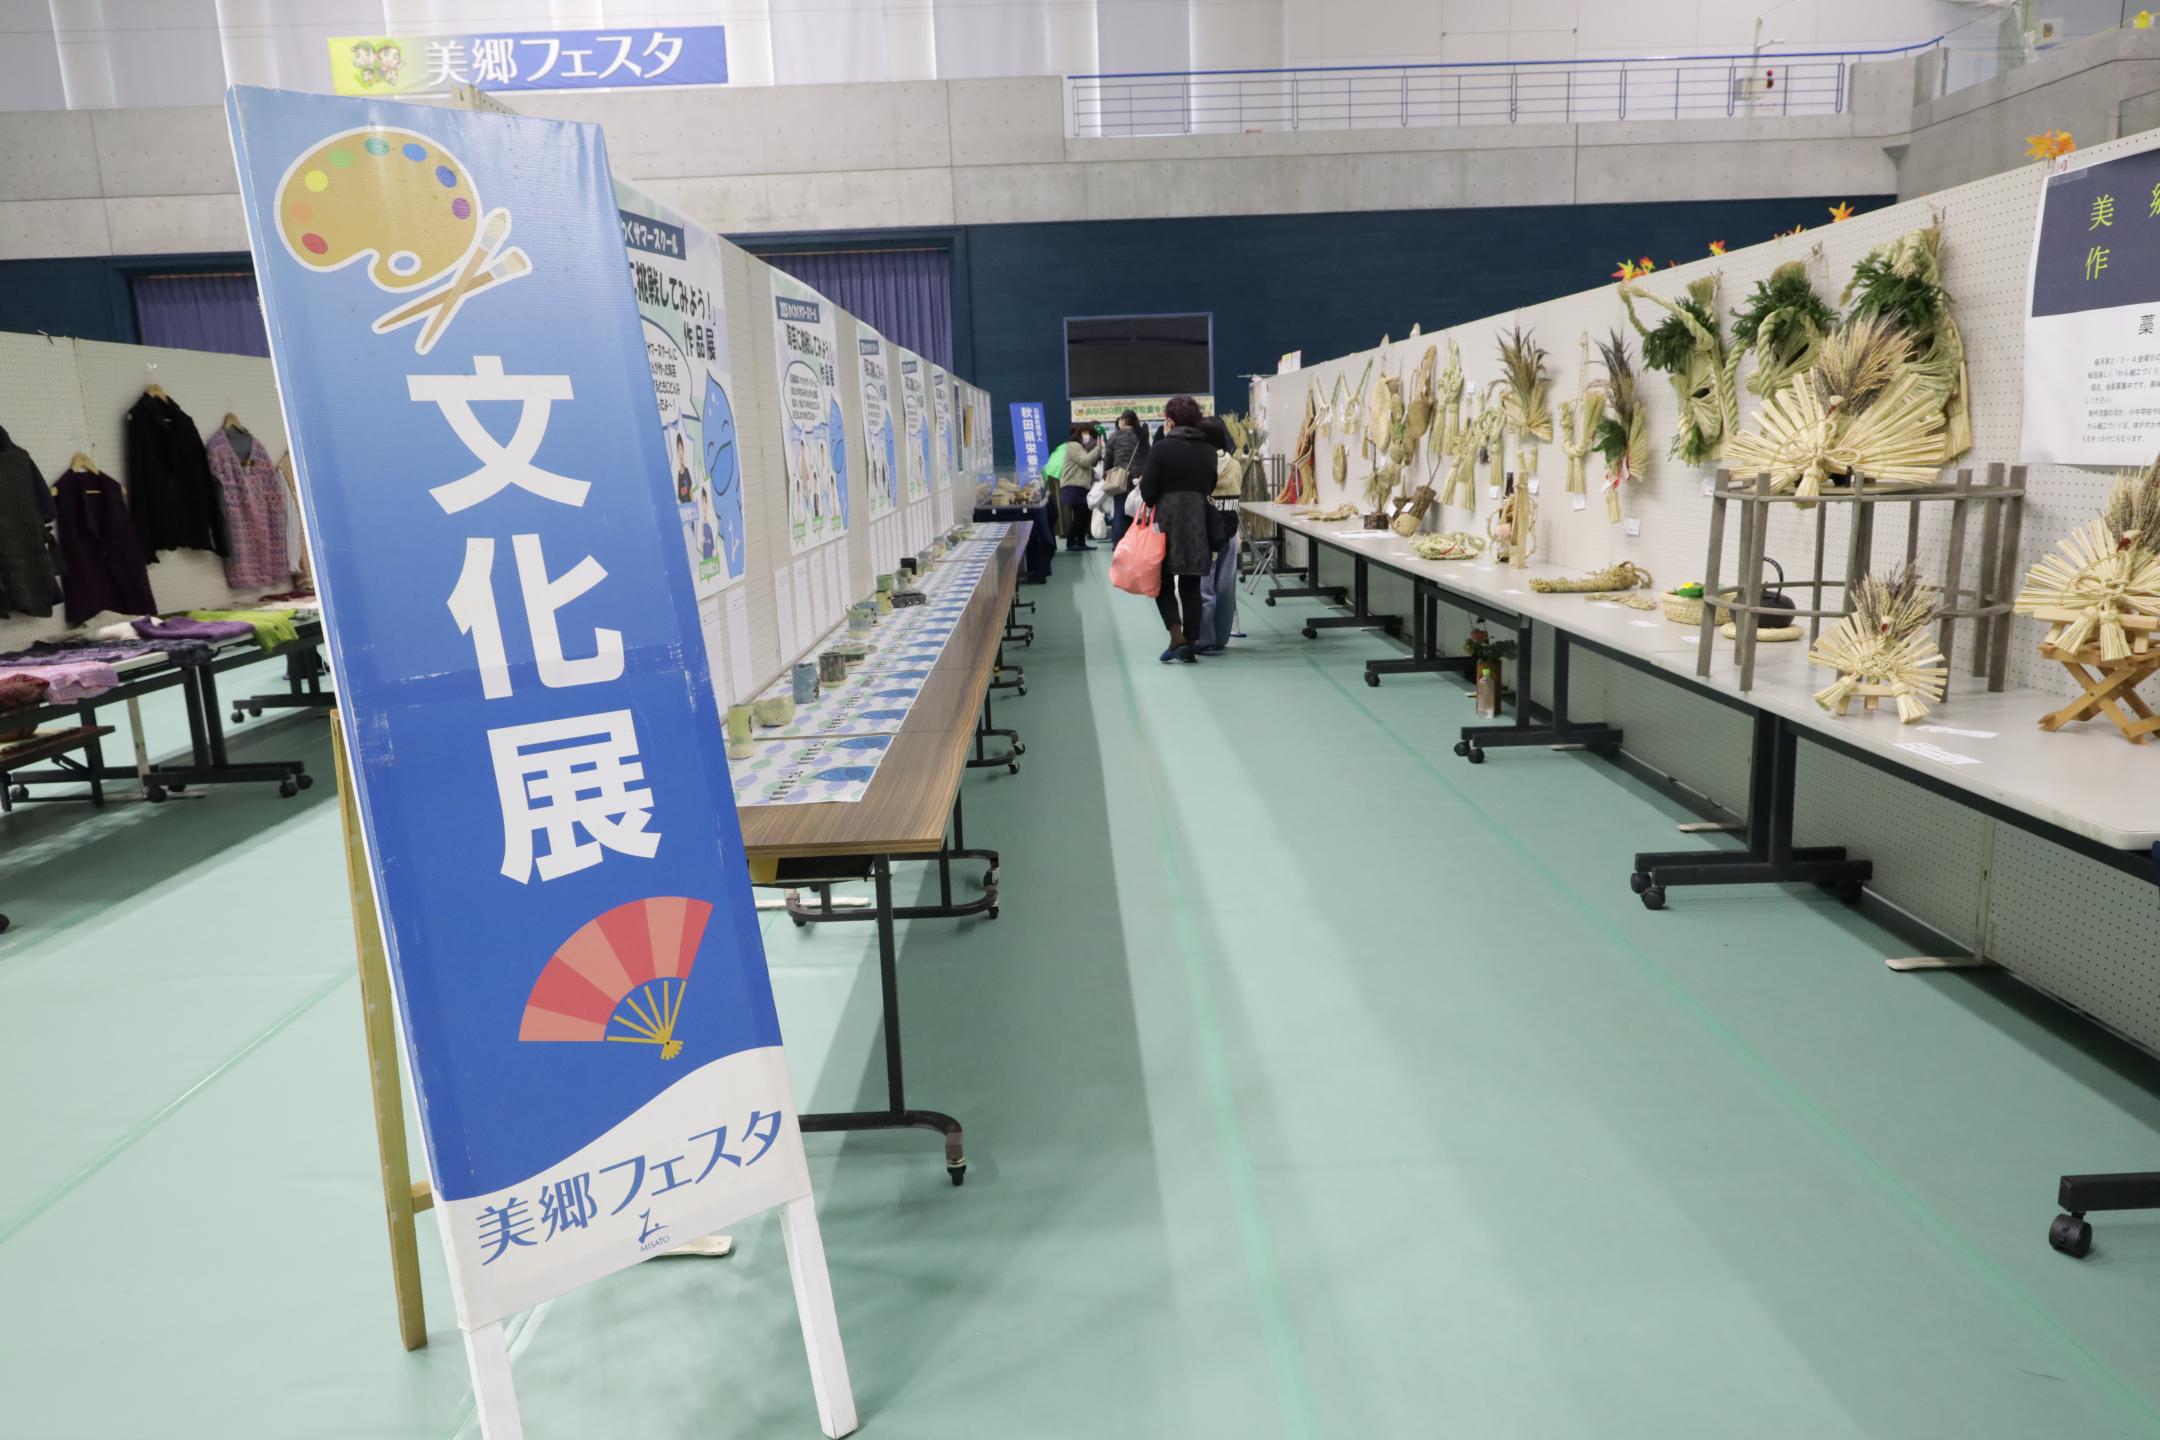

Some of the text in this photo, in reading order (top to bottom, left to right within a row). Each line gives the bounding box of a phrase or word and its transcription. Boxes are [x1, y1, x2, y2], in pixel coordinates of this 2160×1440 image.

[425, 31, 684, 87] 美郷フェスタ
[2085, 246, 2110, 281] 作
[683, 320, 717, 362] 作品展
[405, 355, 662, 885] 文化展
[475, 1109, 782, 1266] 美郷フェスタ
[640, 1235, 671, 1253] MISATO
